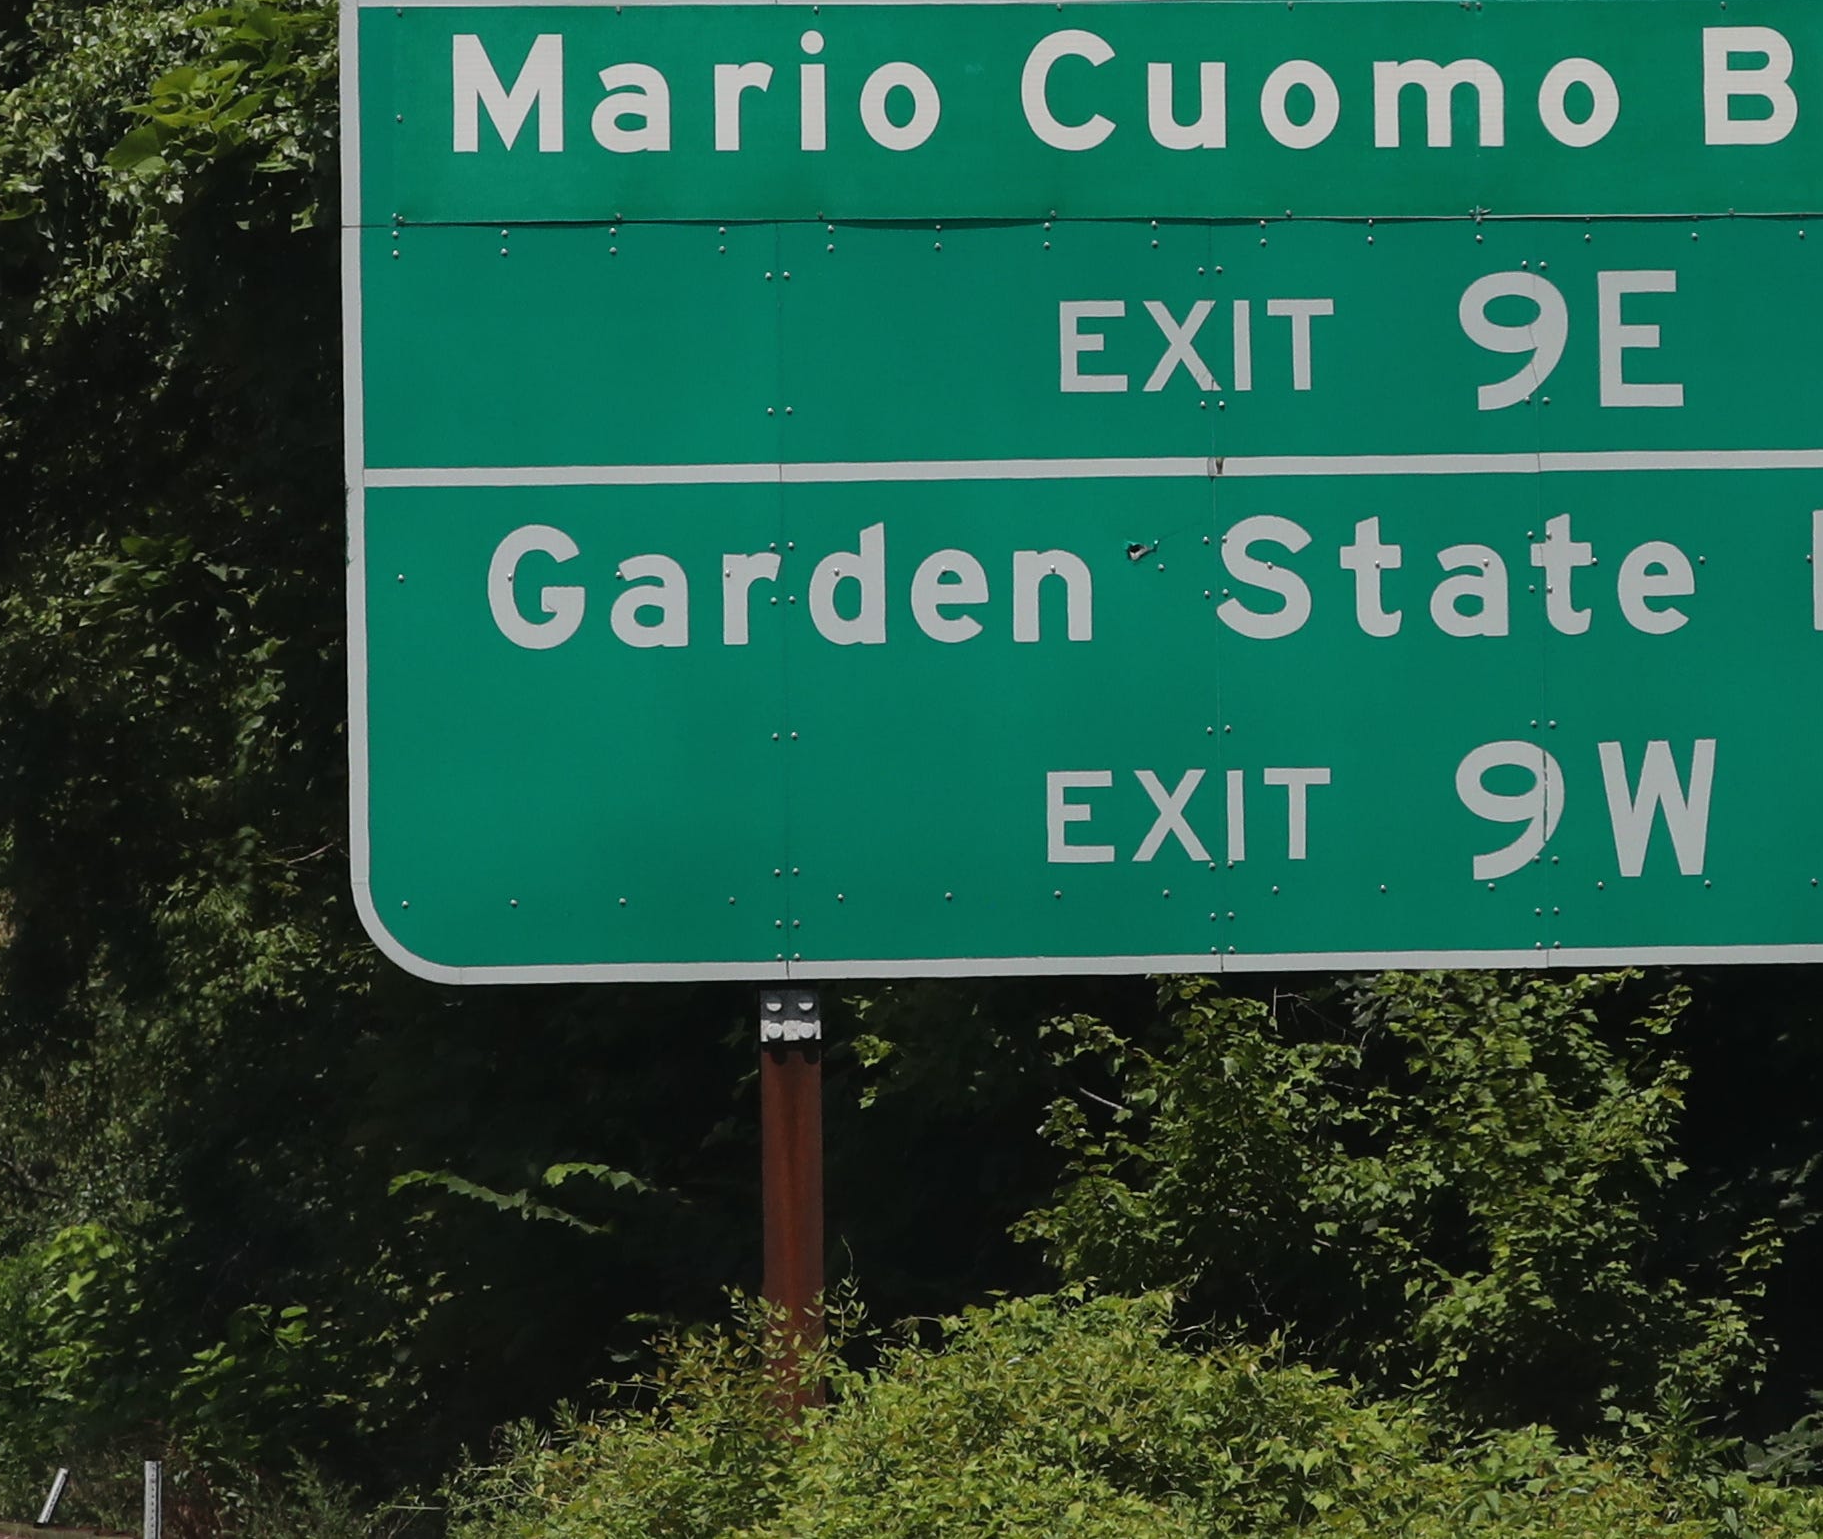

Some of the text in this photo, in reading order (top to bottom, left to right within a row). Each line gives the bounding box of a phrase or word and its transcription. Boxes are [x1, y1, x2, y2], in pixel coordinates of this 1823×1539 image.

[451, 29, 943, 154] Mario
[1020, 28, 1621, 152] Cuomo
[1058, 269, 1685, 412] EXIT 9E
[486, 521, 1094, 651] Garden
[1215, 512, 1696, 641] State
[1045, 737, 1718, 881] EXIT 9W
